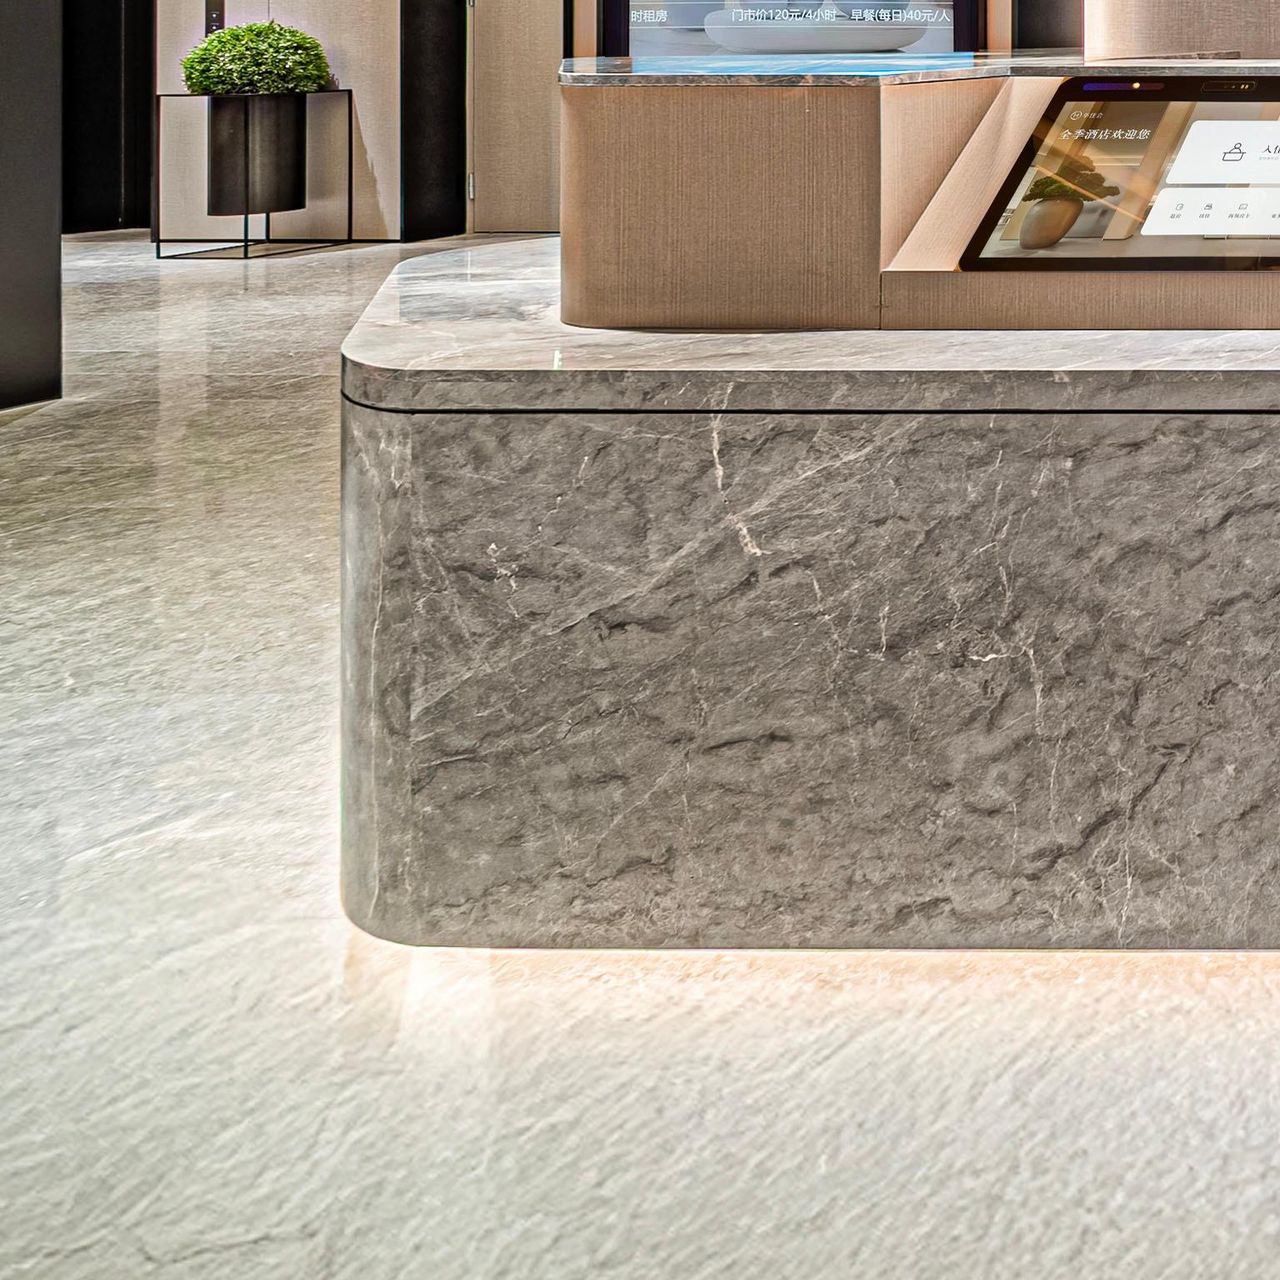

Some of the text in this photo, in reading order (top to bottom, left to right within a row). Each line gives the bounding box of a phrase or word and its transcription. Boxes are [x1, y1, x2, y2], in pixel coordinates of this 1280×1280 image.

[631, 8, 951, 23] 时租房 门市价120元/4小时 早餐(每日)40元/人
[1059, 128, 1152, 140] 全季酒店欢迎您
